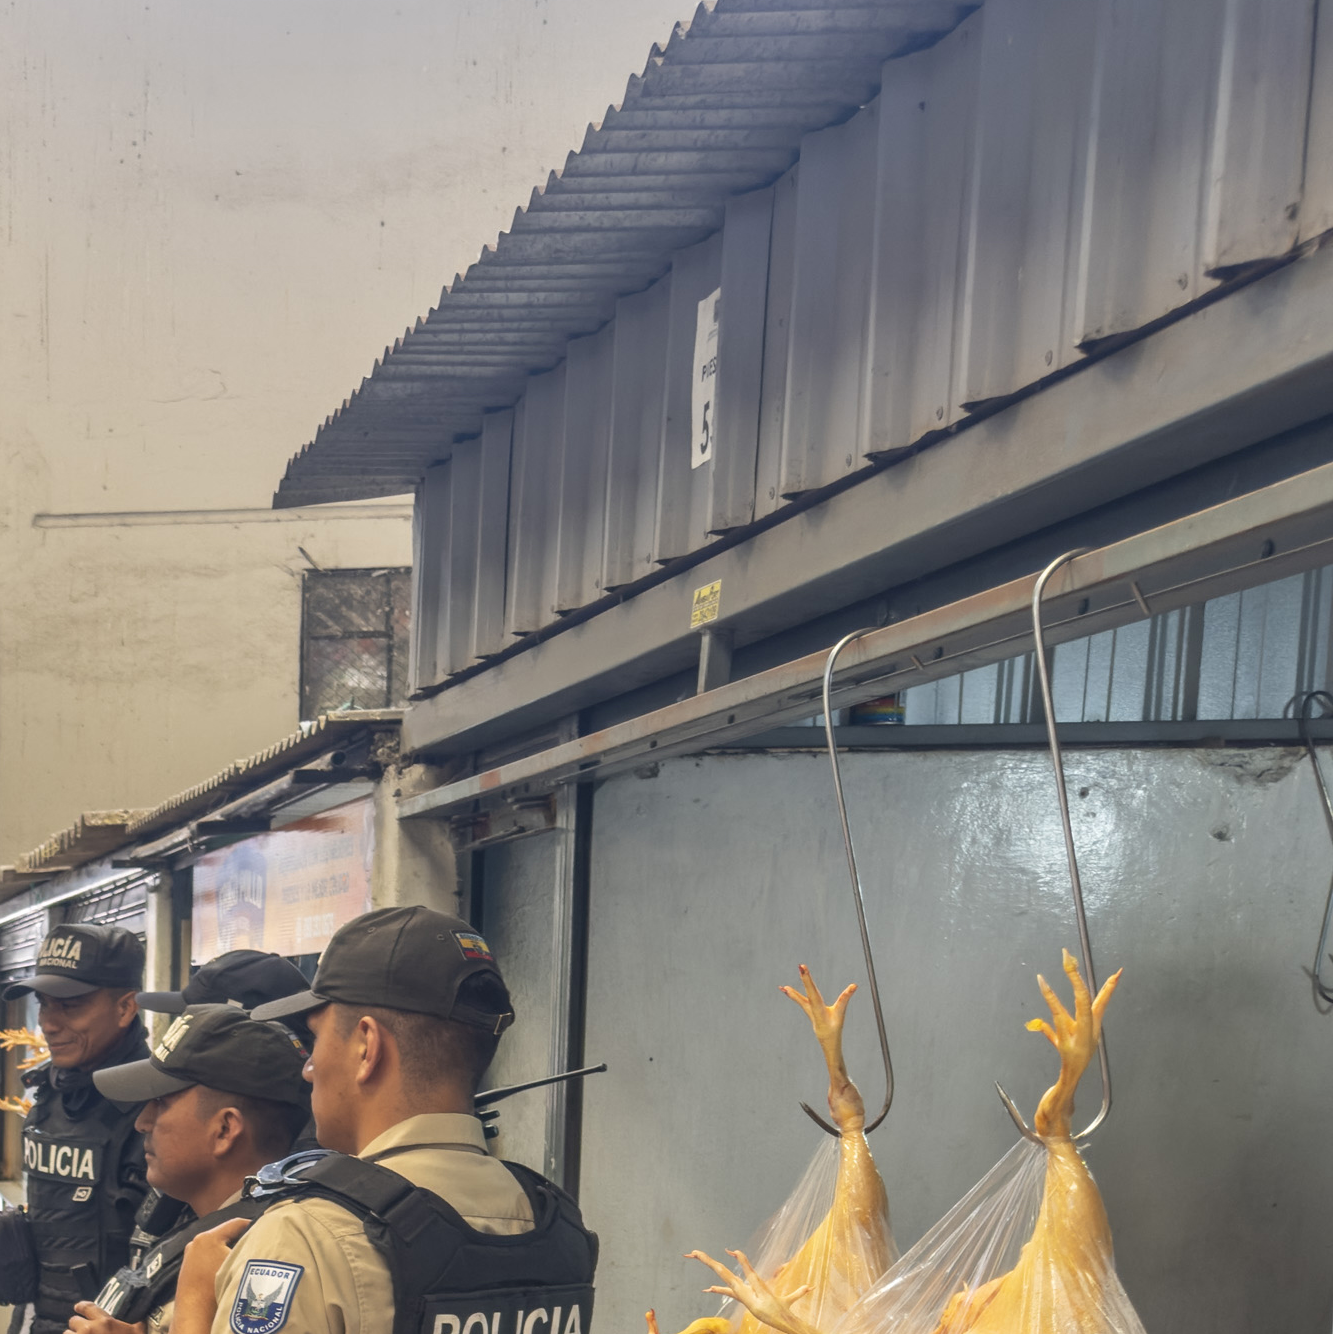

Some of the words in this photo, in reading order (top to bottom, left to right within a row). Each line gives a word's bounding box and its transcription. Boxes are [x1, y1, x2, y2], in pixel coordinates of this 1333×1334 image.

[24, 1137, 94, 1180] POLICIA
[250, 1268, 290, 1279] ECUADOR
[247, 1306, 283, 1333] NACIONAL
